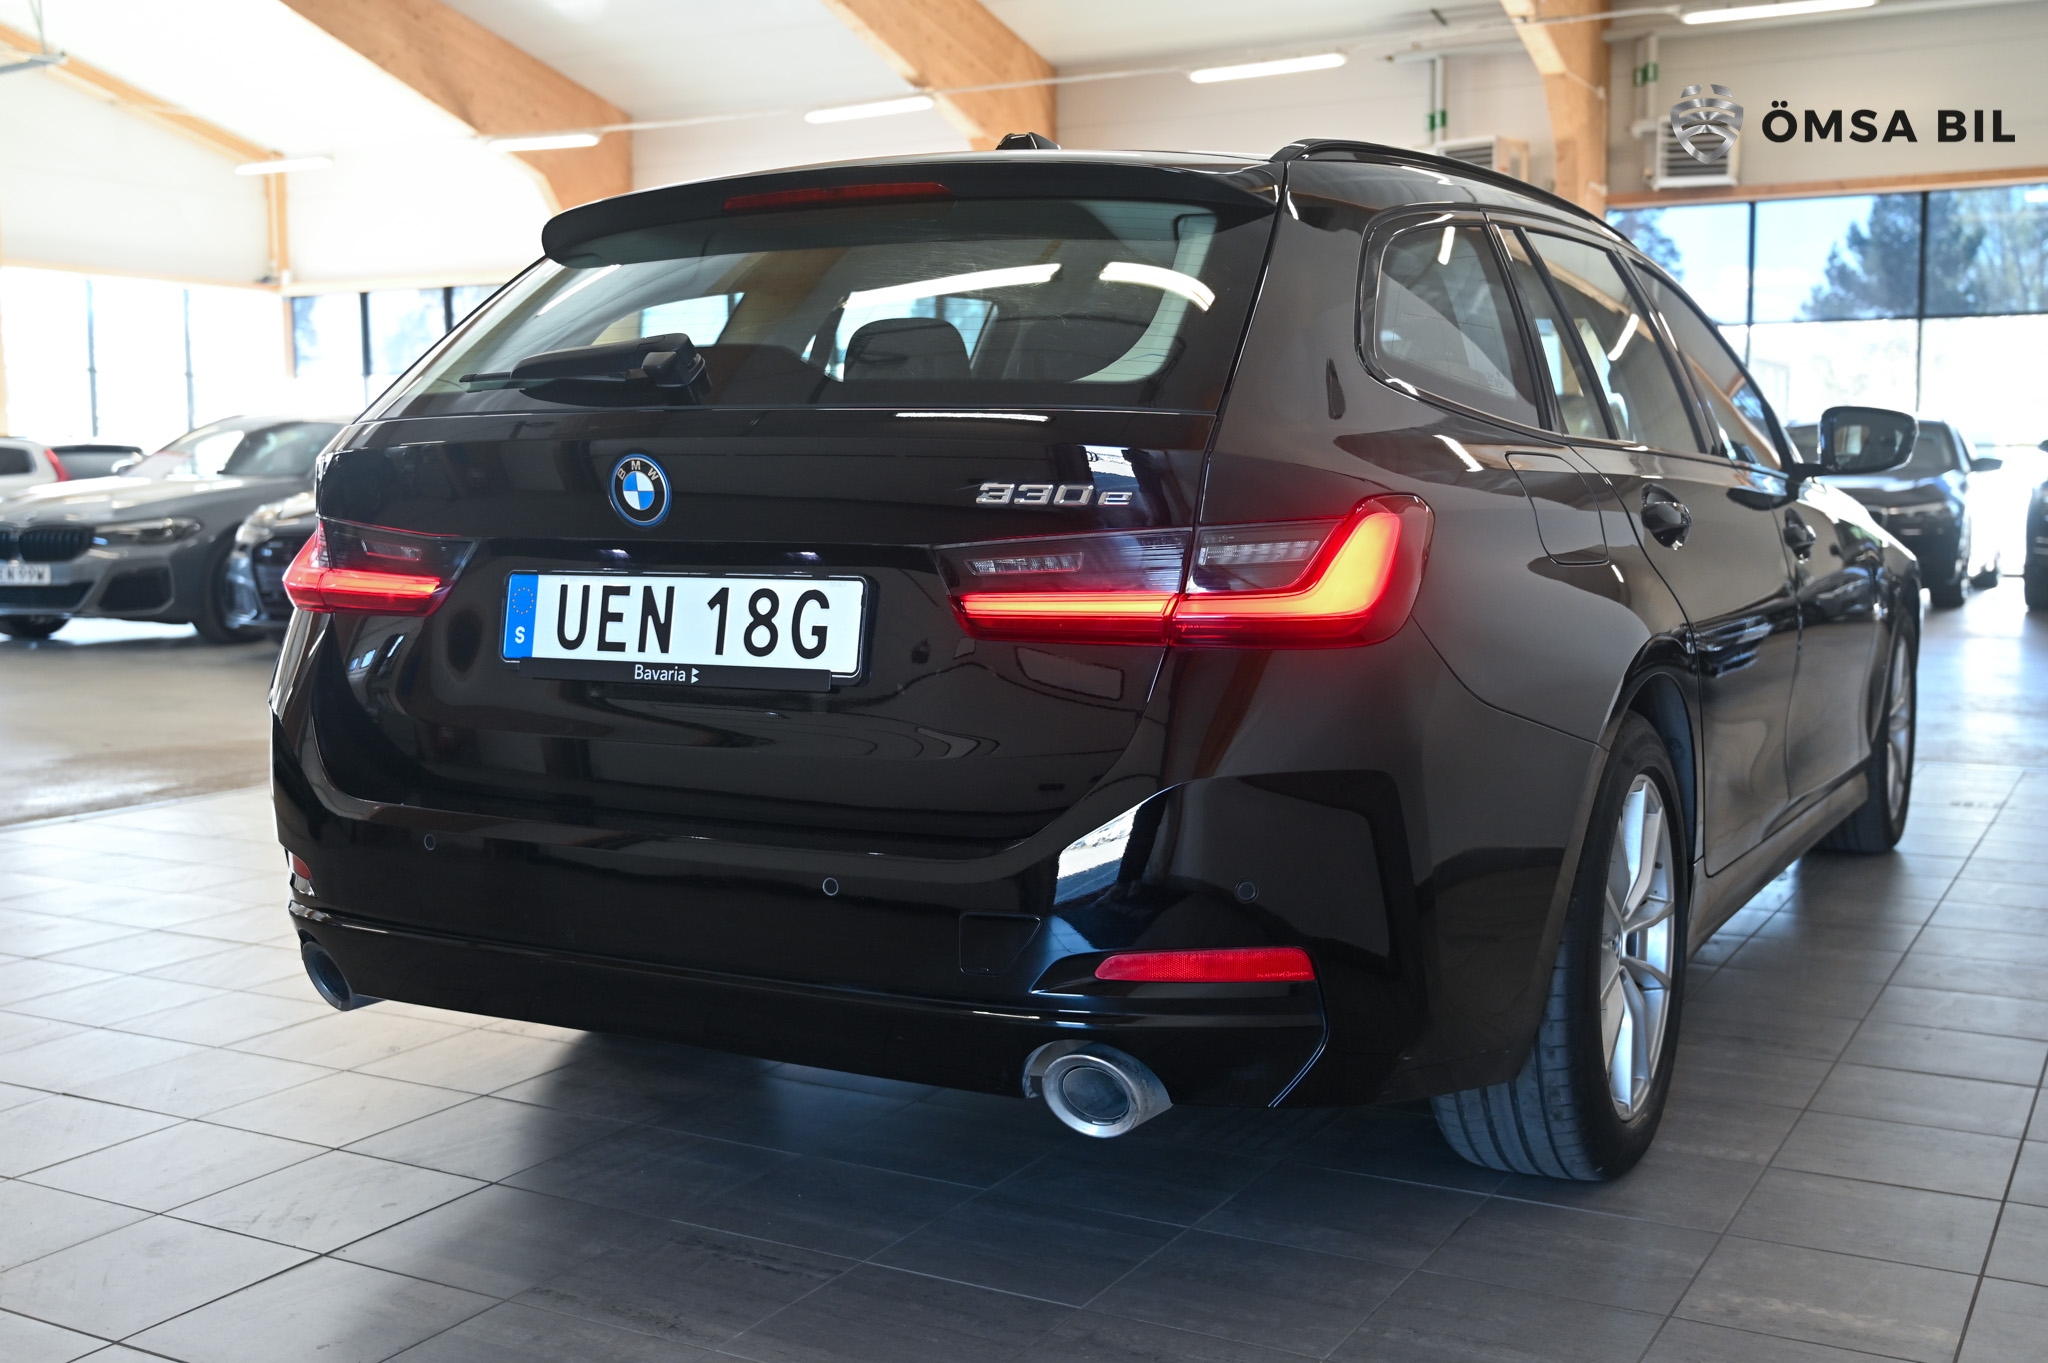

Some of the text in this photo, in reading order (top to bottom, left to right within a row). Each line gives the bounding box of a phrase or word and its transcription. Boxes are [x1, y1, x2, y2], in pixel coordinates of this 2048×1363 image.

[616, 460, 660, 481] BMW
[514, 583, 830, 660] S UEN 18G
[634, 663, 686, 682] Bavaria
